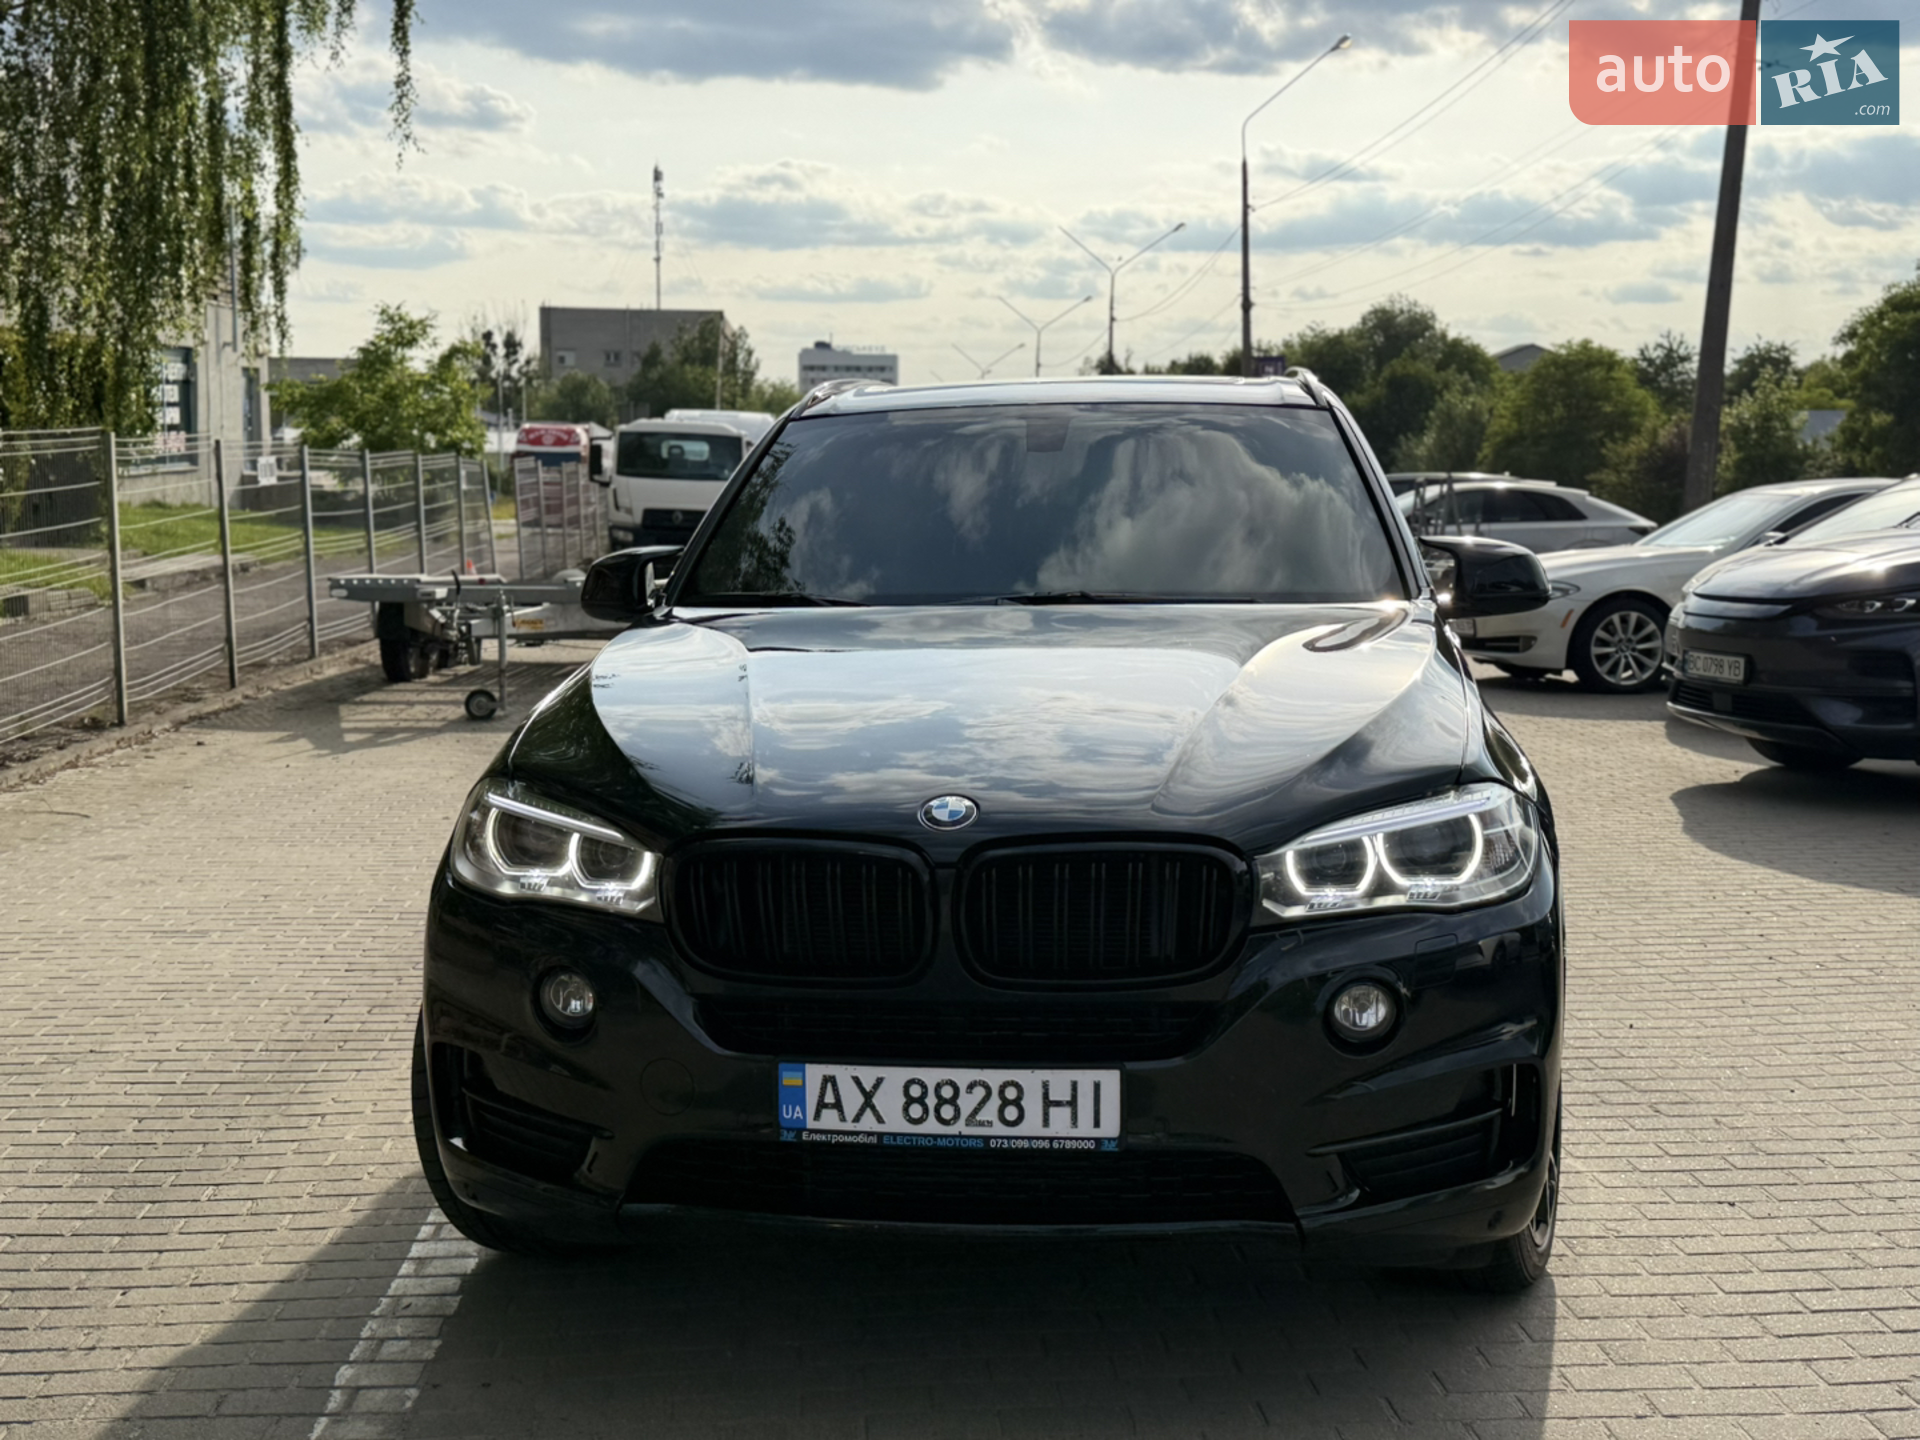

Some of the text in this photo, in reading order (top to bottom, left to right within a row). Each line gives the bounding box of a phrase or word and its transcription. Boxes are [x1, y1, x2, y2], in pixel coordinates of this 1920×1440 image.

[812, 1074, 1101, 1129] AX 8828 HI
[783, 1104, 804, 1120] UA
[883, 1135, 984, 1148] ELECTRO-MOTORS
[1052, 1138, 1096, 1150] 6789000
